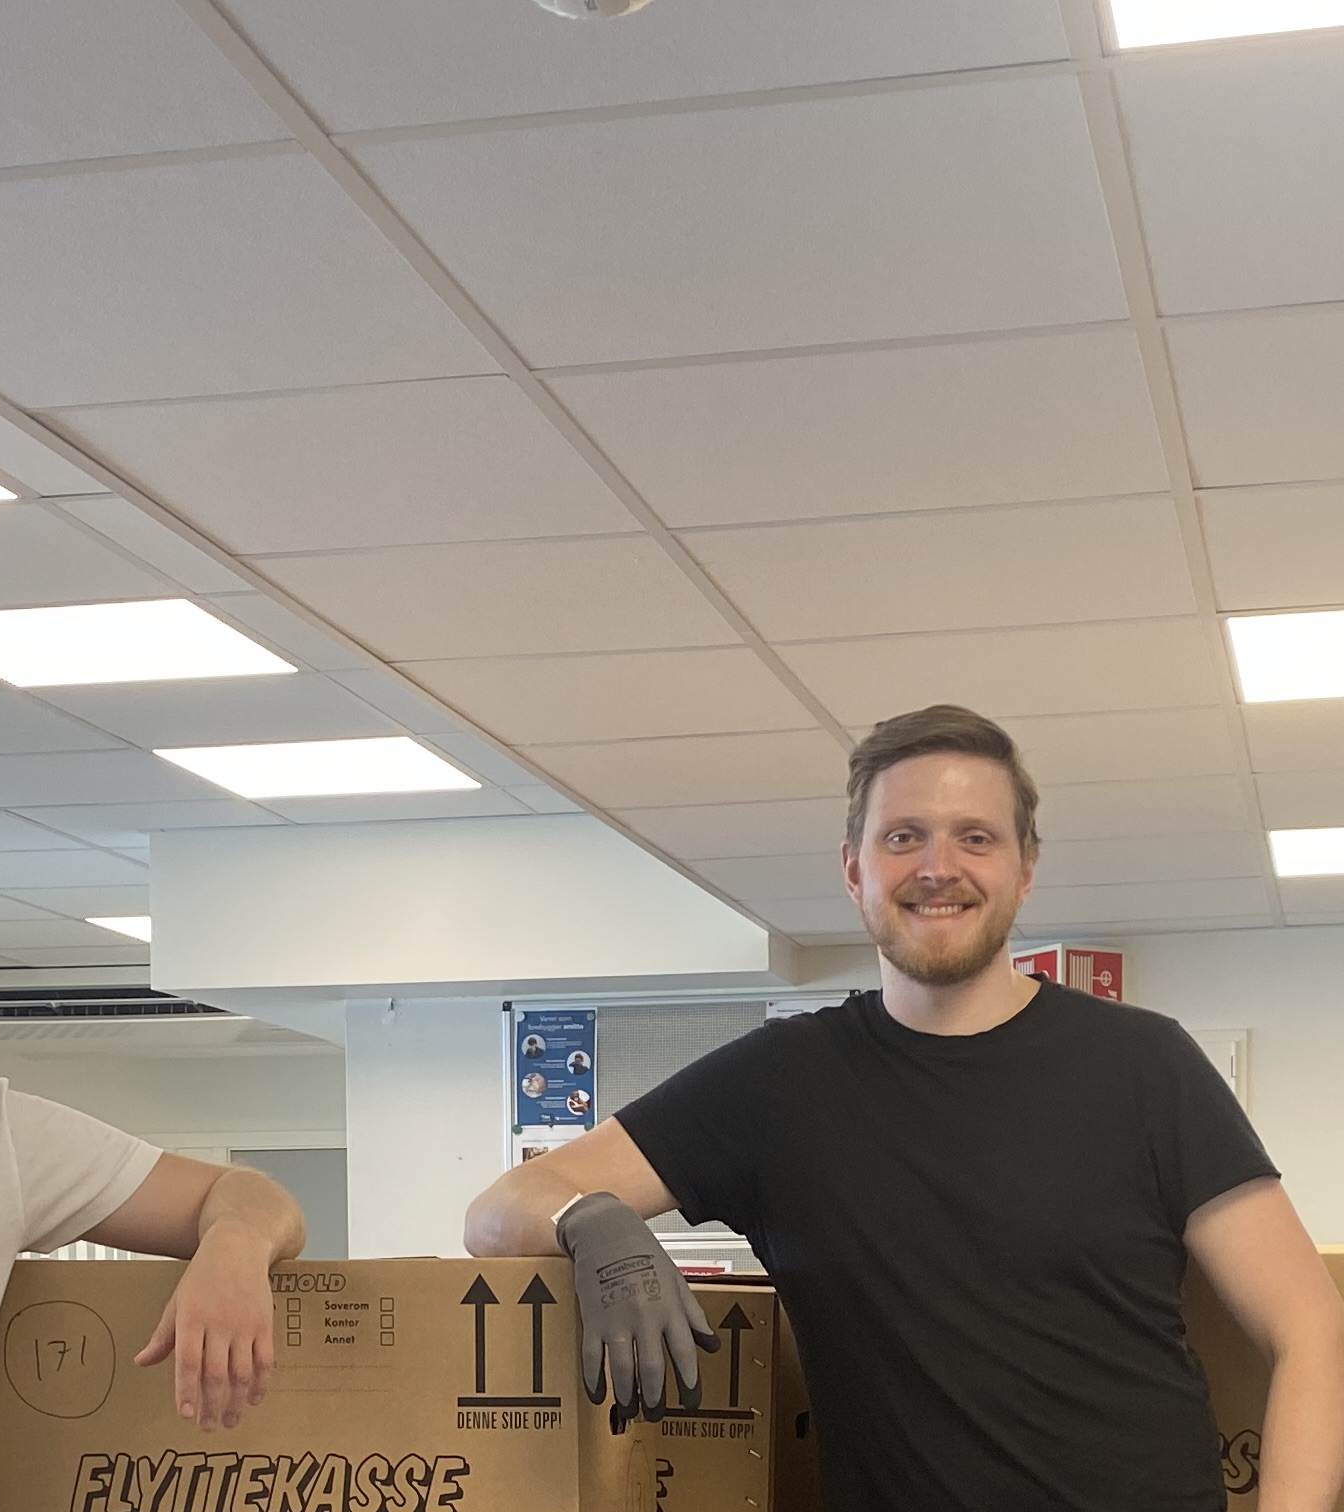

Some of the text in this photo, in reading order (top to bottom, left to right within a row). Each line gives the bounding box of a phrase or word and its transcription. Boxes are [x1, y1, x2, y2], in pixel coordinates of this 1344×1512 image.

[268, 1273, 346, 1293] NHOLD
[324, 1300, 369, 1311] Soverom
[324, 1317, 360, 1328] Kontor
[324, 1334, 355, 1344] Annet
[35, 1335, 86, 1382] 171
[457, 1411, 561, 1430] DENNE SIDE OPP!
[661, 1420, 755, 1440] DENNE SIDE OPP!
